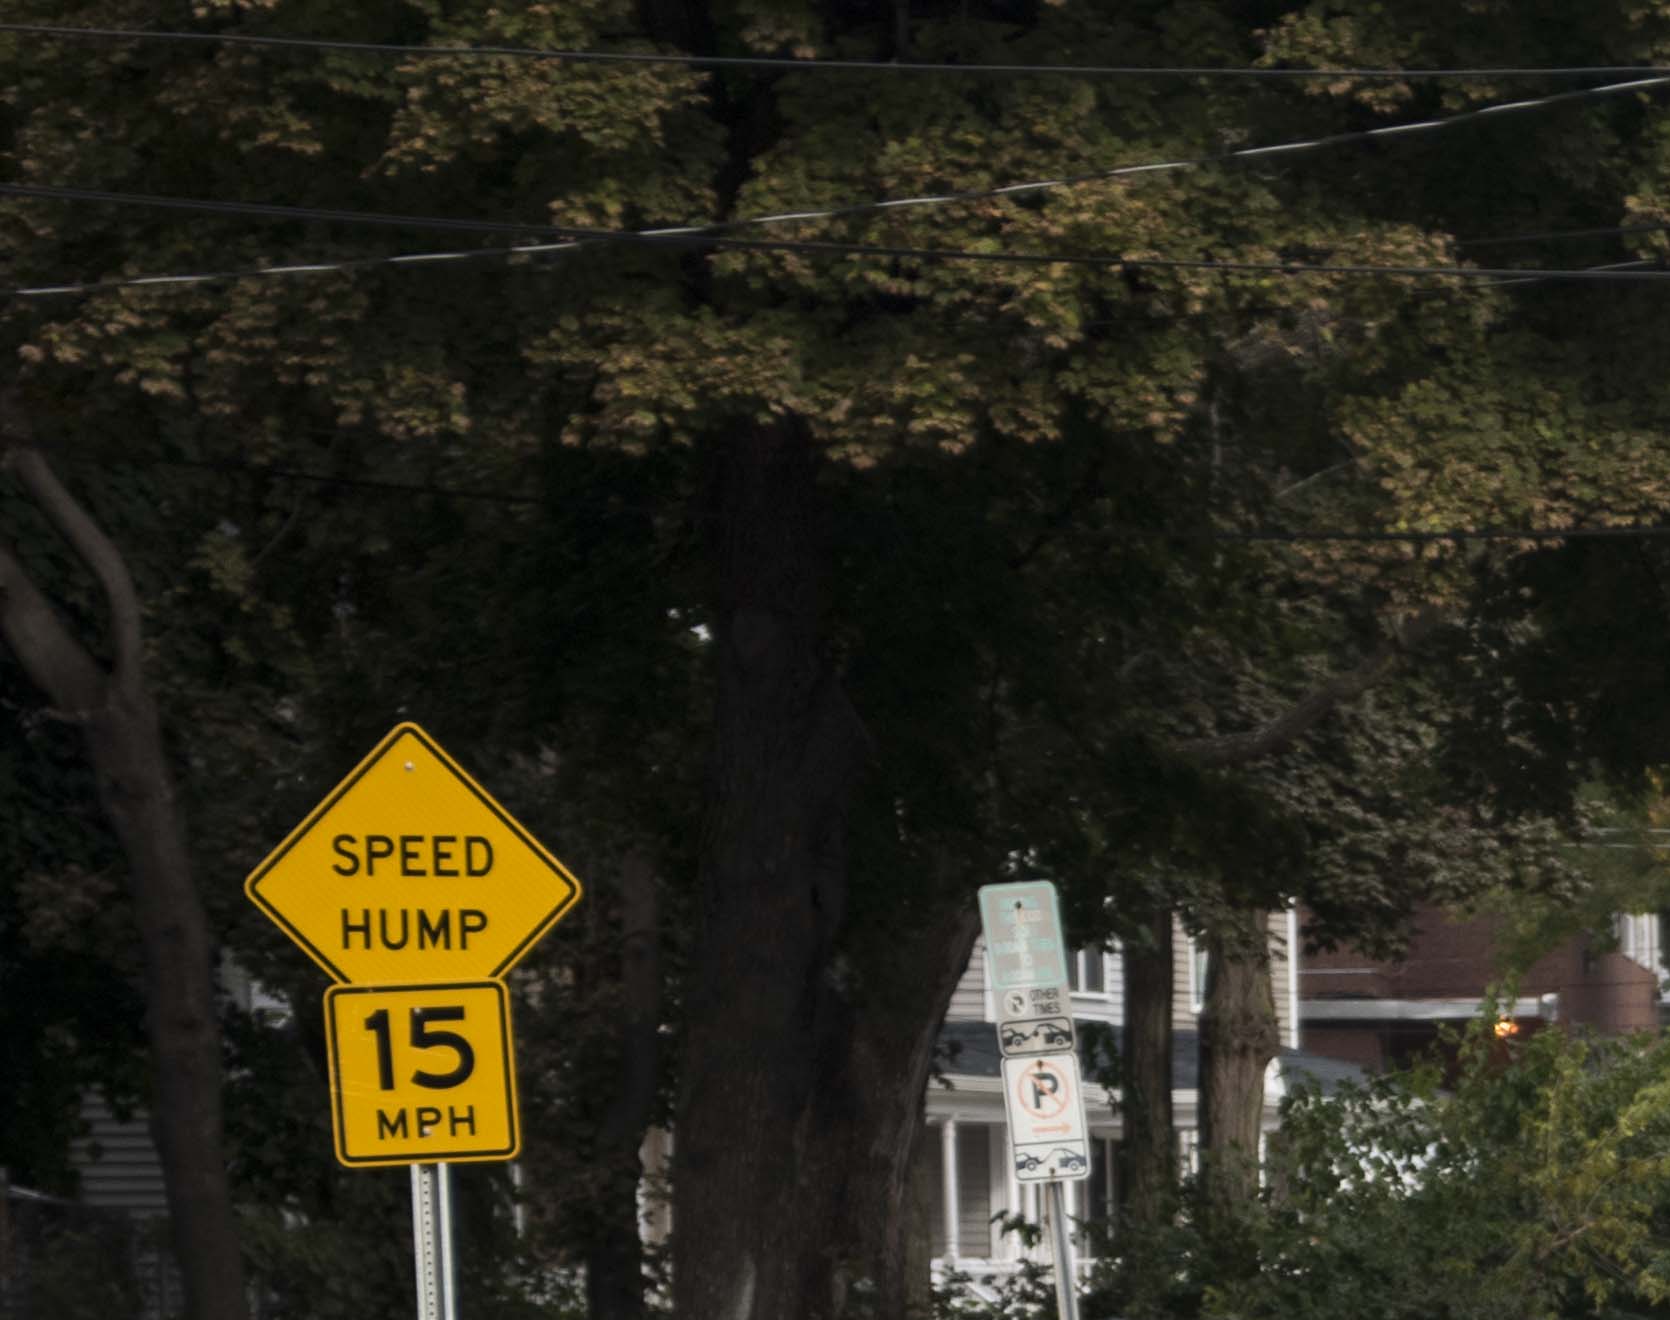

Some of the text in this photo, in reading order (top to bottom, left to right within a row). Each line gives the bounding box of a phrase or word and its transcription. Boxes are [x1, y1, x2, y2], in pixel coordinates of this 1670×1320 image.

[332, 834, 494, 877] SPEED
[340, 909, 488, 950] HUMP
[363, 1005, 475, 1091] 15
[377, 1104, 476, 1140] MPH
